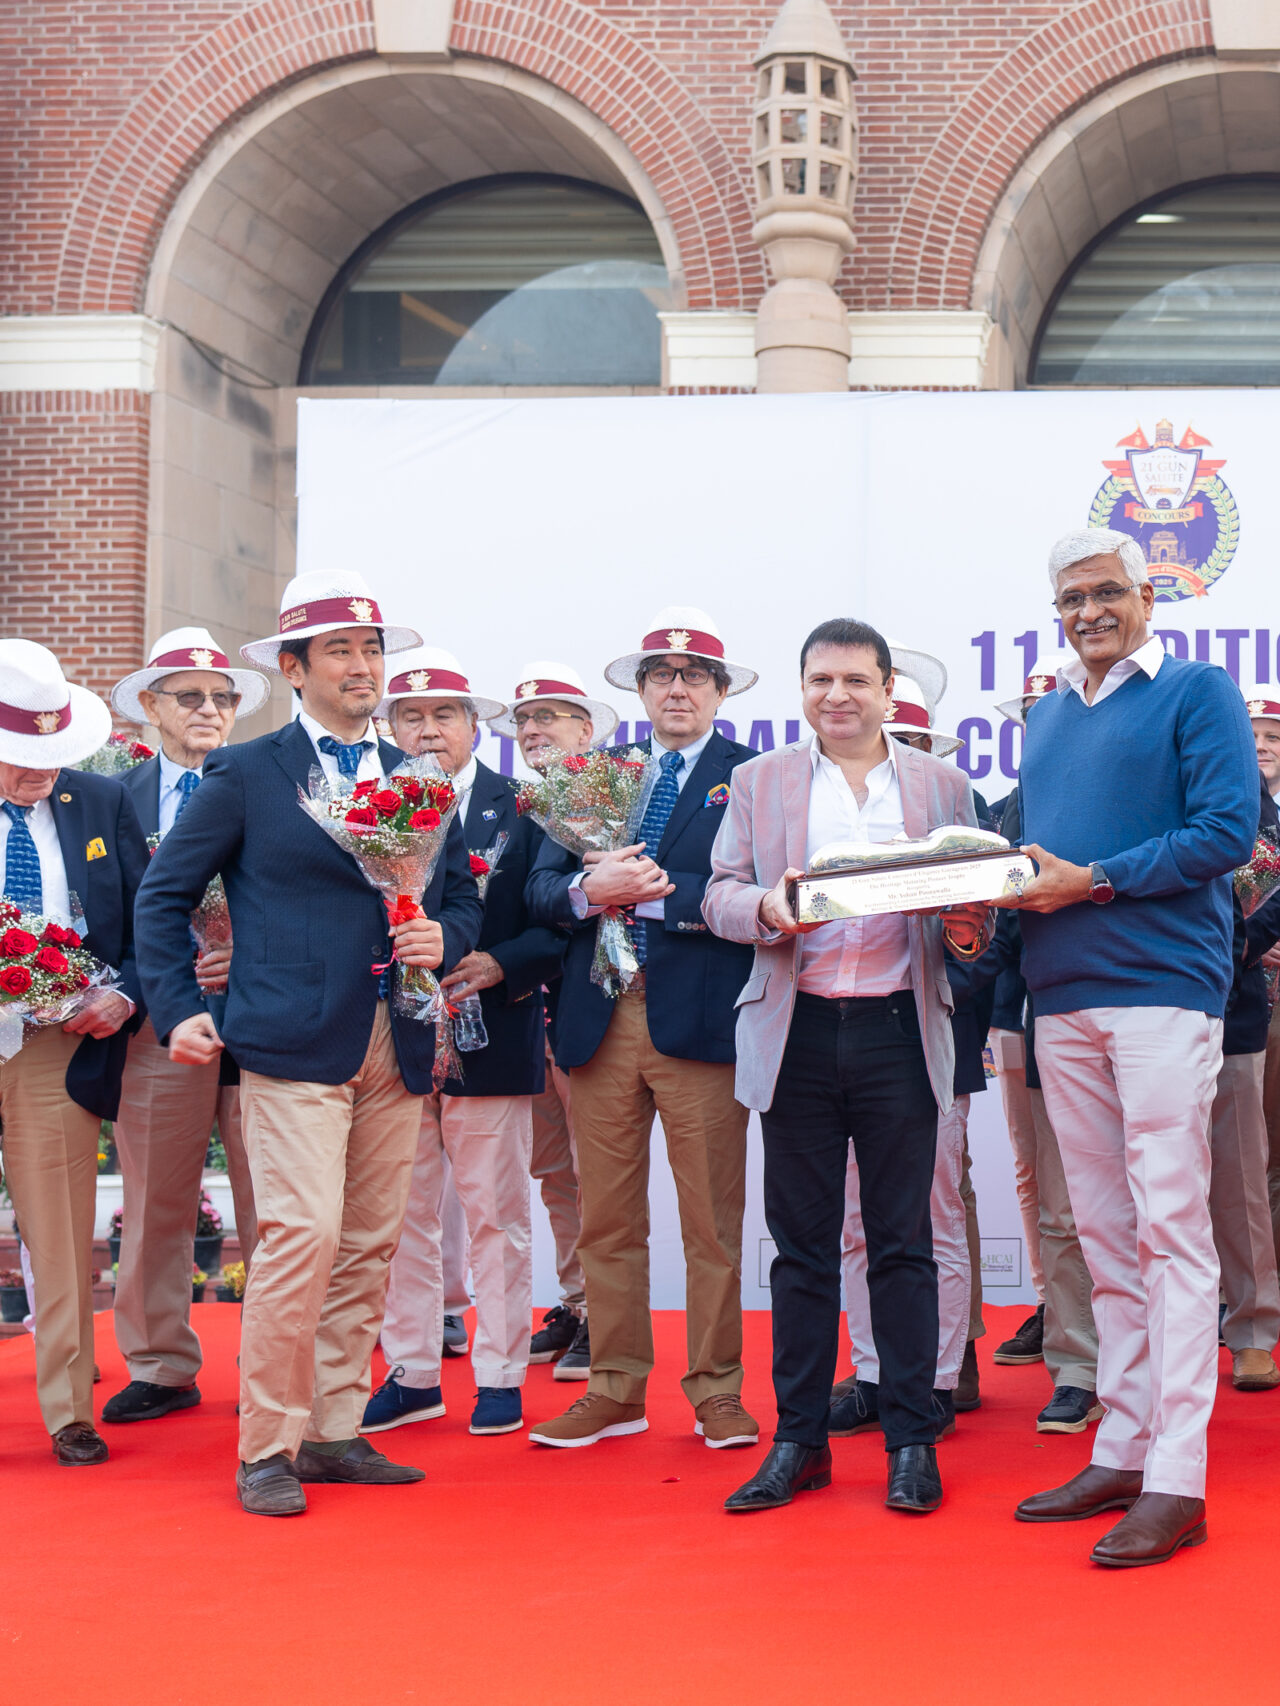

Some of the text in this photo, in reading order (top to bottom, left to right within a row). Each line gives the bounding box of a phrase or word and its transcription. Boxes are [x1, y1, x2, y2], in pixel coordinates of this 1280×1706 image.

[1140, 462, 1188, 472] 21 GUN
[1144, 473, 1185, 483] SALUTE
[1137, 510, 1191, 521] CONCOURS
